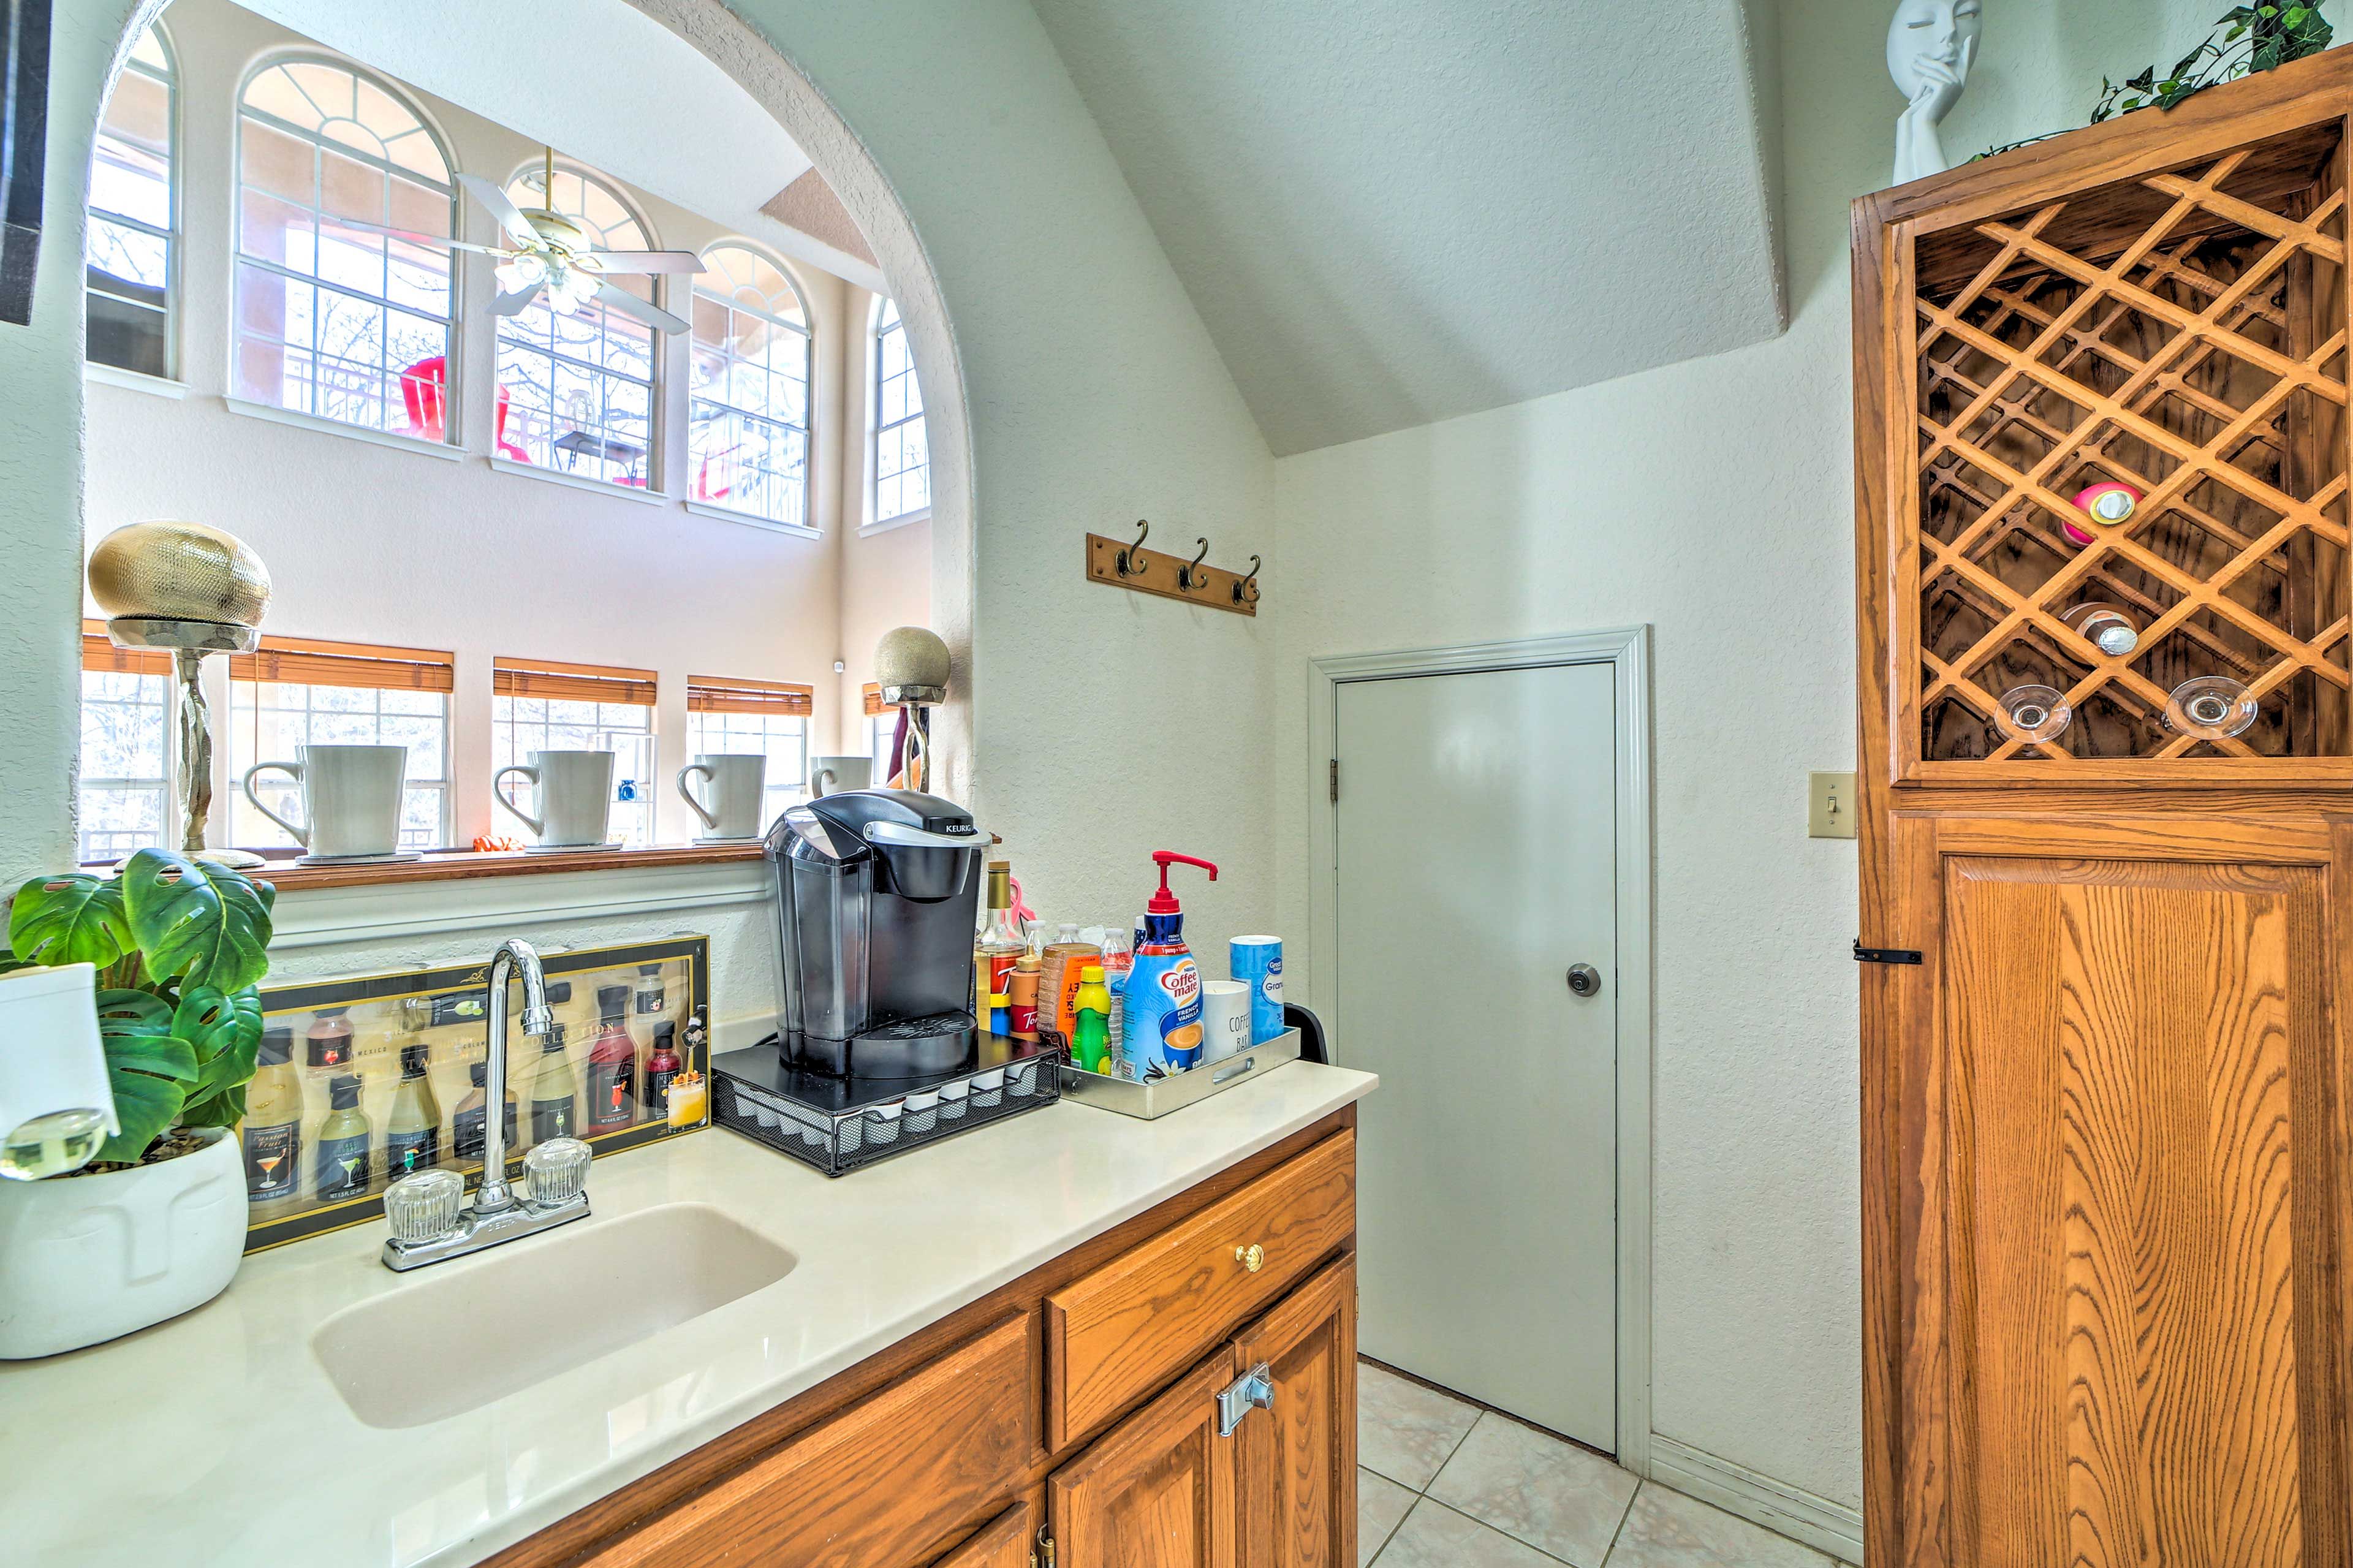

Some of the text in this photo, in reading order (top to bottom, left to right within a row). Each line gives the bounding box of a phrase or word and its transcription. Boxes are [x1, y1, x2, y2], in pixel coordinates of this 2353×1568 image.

[945, 824, 971, 833] KEURIG
[1161, 971, 1197, 990] Coffee
[1173, 982, 1197, 998] mate
[1177, 1002, 1199, 1017] FRENCH
[1178, 1009, 1199, 1022] VANILLA
[358, 1047, 387, 1055] MEXICO
[253, 1132, 289, 1142] Passion
[258, 1140, 282, 1148] Fruit
[511, 1165, 520, 1174] OZ
